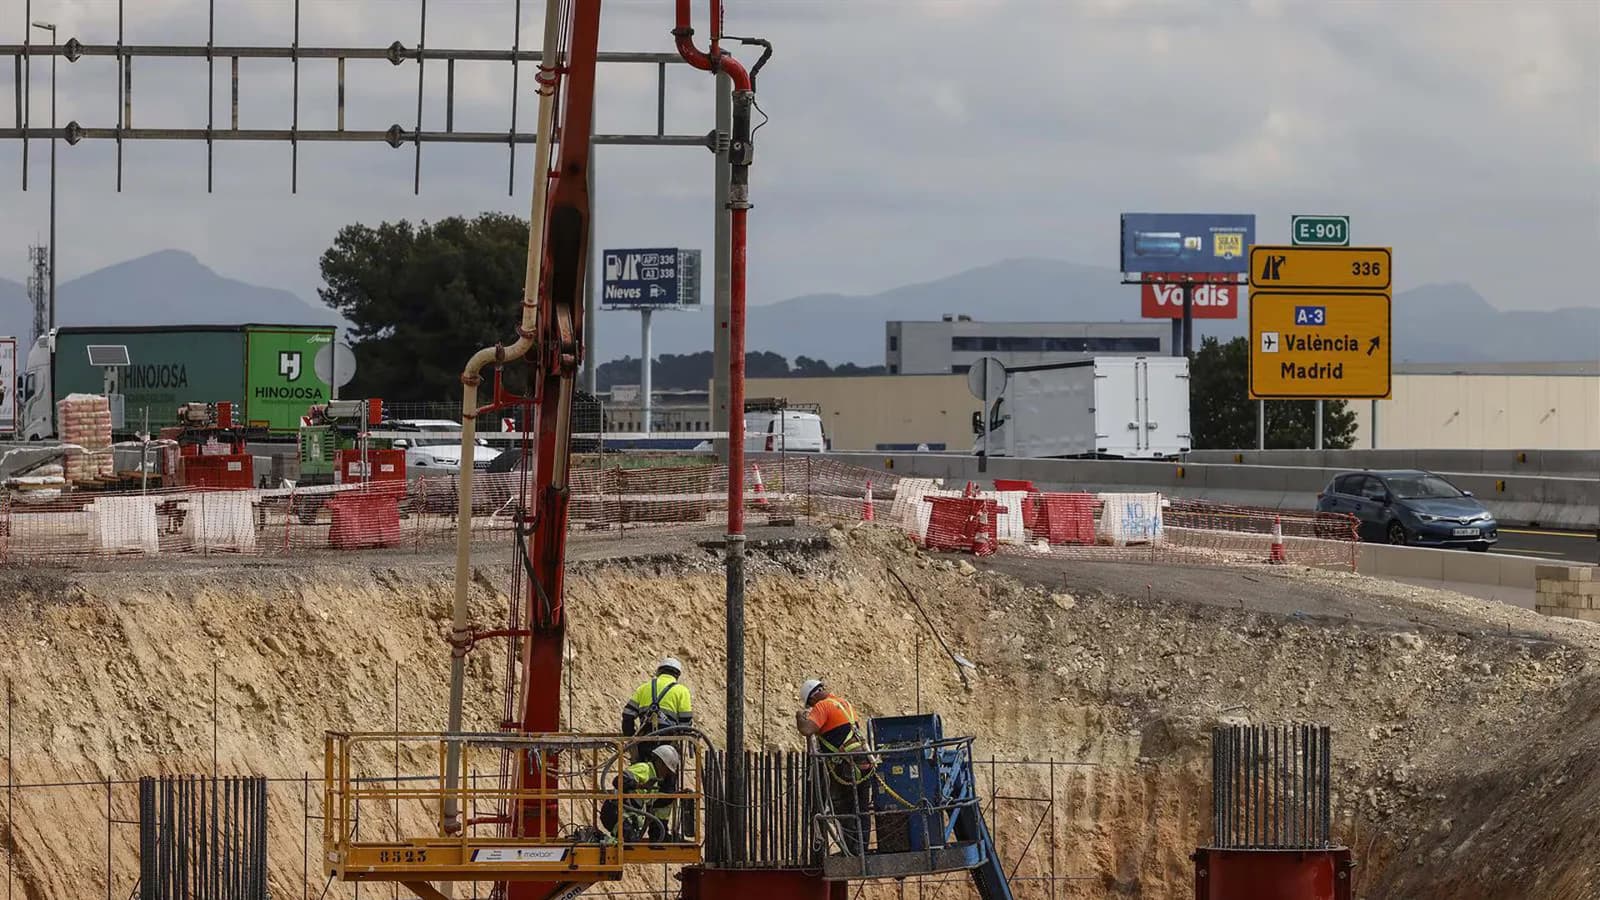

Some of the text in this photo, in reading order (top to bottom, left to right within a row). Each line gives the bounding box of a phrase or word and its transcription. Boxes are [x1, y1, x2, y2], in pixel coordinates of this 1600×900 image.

[1300, 223, 1342, 238] E-901
[660, 254, 675, 265] 336
[660, 268, 675, 279] 338
[1352, 262, 1381, 276] 336
[605, 284, 641, 299] Nieves
[1152, 283, 1229, 306] Vodis
[1297, 309, 1324, 324] A-3
[1285, 334, 1359, 351] València
[124, 363, 188, 389] HINOJOSA
[1281, 362, 1343, 379] Madrid
[255, 386, 323, 399] HINOJOSA
